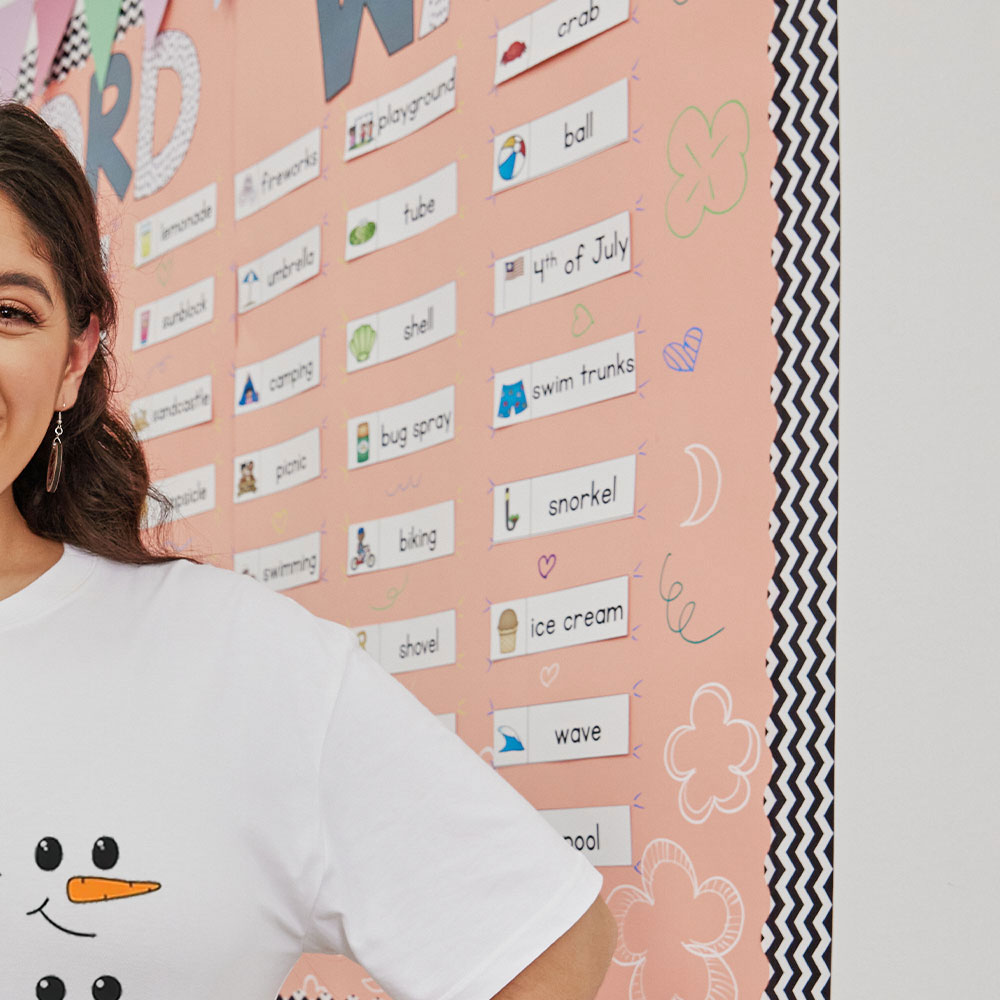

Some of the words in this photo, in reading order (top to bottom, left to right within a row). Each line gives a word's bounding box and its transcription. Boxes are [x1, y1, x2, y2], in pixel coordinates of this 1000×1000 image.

[557, 0, 601, 38] crab
[377, 65, 457, 137] playground
[563, 110, 594, 149] ball
[260, 146, 318, 195] fireworks
[160, 200, 213, 242] lemonade
[403, 195, 436, 225] tube
[266, 246, 315, 287] umbrella
[532, 250, 558, 284] 4th
[563, 243, 585, 275] of
[591, 230, 629, 265] July
[403, 306, 436, 341] shell
[269, 361, 314, 392] camping
[531, 375, 575, 400] swim
[580, 352, 636, 387] trunks
[381, 424, 408, 448] bug
[412, 410, 452, 442] spray
[275, 455, 308, 485] picnic
[548, 475, 618, 517] snorkel
[399, 525, 438, 553] biking
[262, 554, 318, 583] swimming
[530, 617, 557, 639] ice
[562, 603, 625, 633] cream
[398, 627, 440, 660] shovel
[554, 724, 602, 745] wave
